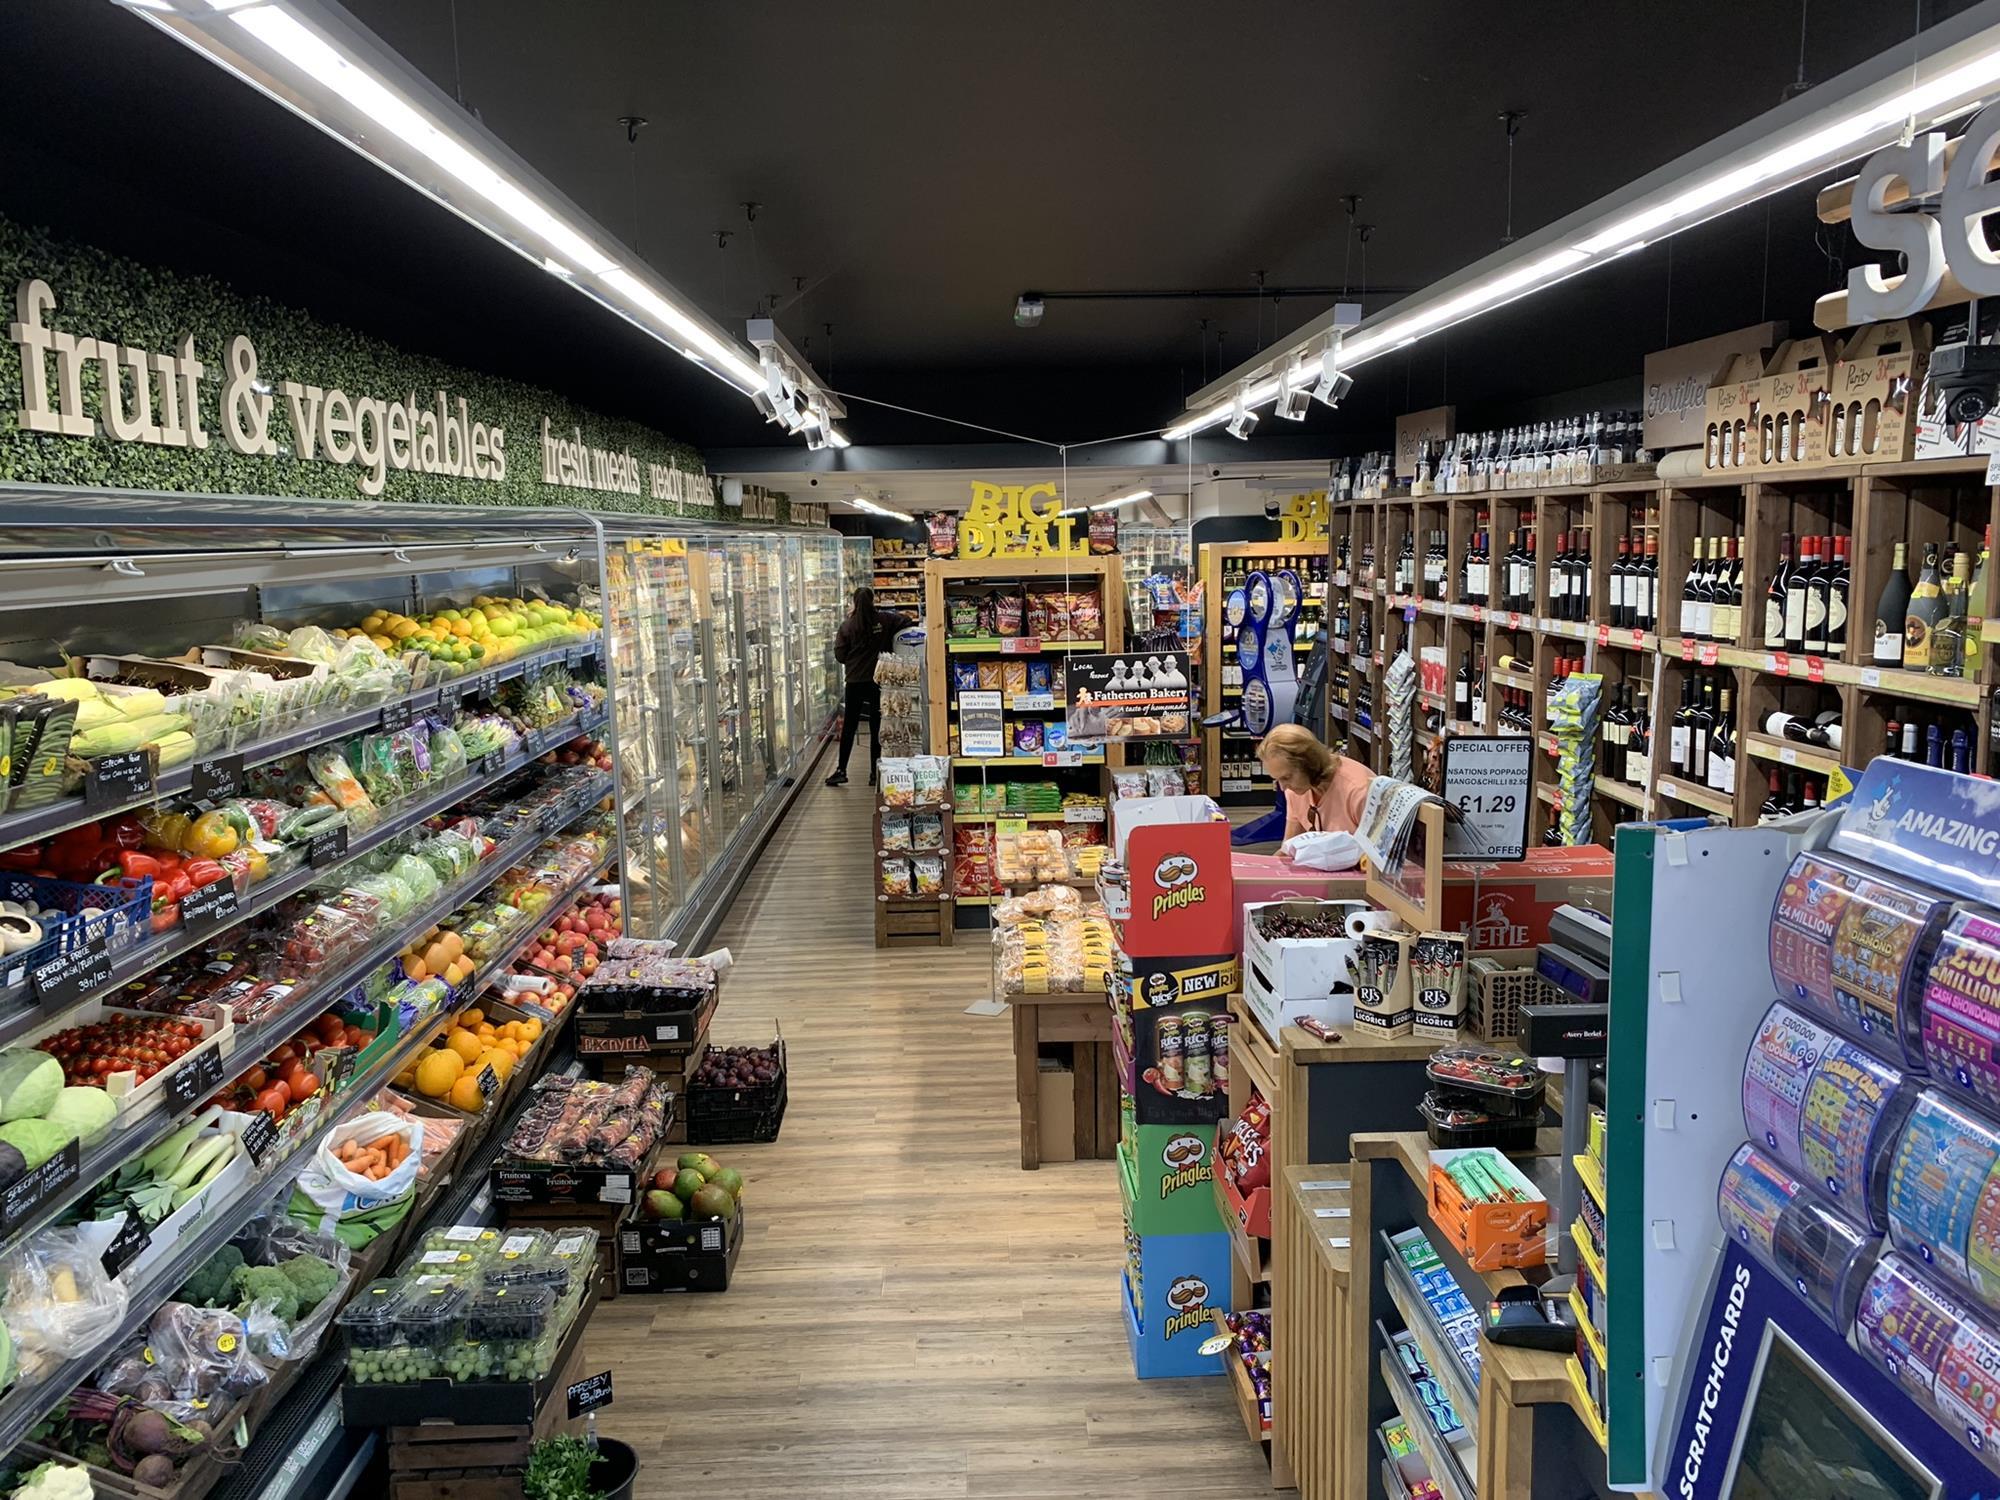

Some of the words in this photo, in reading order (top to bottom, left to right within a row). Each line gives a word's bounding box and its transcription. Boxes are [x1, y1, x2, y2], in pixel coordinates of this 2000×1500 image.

[10, 279, 207, 448] fruit
[221, 334, 277, 455] &
[279, 380, 505, 495] vegetables
[1772, 377, 1795, 401] Purity
[1846, 364, 1872, 391] Purity
[1717, 388, 1737, 411] Purity
[540, 416, 594, 489] fresh
[594, 447, 640, 494] meats
[650, 456, 684, 514] ready
[684, 466, 714, 506] meals
[1595, 465, 1625, 482] Purity
[965, 480, 1062, 524] BIG
[1287, 490, 1328, 518] BI
[959, 517, 1090, 559] DEAL
[1278, 515, 1328, 543] DE
[1094, 690, 1147, 701] Fatherson
[1150, 689, 1187, 701] Bakery
[1142, 704, 1150, 715] of
[1151, 703, 1187, 711] homemade
[1449, 743, 1493, 752] SPECIAL
[1496, 743, 1530, 753] OFFER
[887, 774, 910, 783] LENTIL
[914, 770, 940, 780] VEGGIE
[1459, 795, 1516, 813] £1.29
[1896, 808, 1999, 856] AMAZING
[1487, 846, 1522, 854] OFFER
[1152, 884, 1206, 921] Pringles
[1778, 902, 1790, 917] £4
[1790, 905, 1834, 937] MILLION
[1460, 920, 1529, 947] KETTLE
[1850, 930, 1893, 955] DIAMOND
[36, 957, 69, 981] SPECIAL
[1183, 973, 1218, 993] NEW
[1938, 966, 2000, 1009] MILLION
[1151, 993, 1173, 1003] RICE
[1361, 988, 1380, 1004] RJ's
[1424, 990, 1447, 1004] RJ's
[1931, 986, 1953, 1004] CASH
[1952, 995, 2000, 1028] SHOWDOWN
[1355, 1012, 1387, 1026] LICORICE
[1415, 1015, 1454, 1027] LICORICE
[1161, 1035, 1182, 1048] RICE
[1185, 1032, 1209, 1047] RICE
[1211, 1034, 1228, 1047] RIC
[8, 1171, 41, 1203] SPECIAL
[500, 1171, 531, 1179] Fruitona
[546, 1178, 578, 1186] Fruitona
[1160, 1162, 1212, 1199] Pringles
[1164, 1305, 1215, 1341] Pringles
[568, 1374, 608, 1400] PARSLEY
[1679, 1264, 1750, 1500] SCRATCHCARDS
